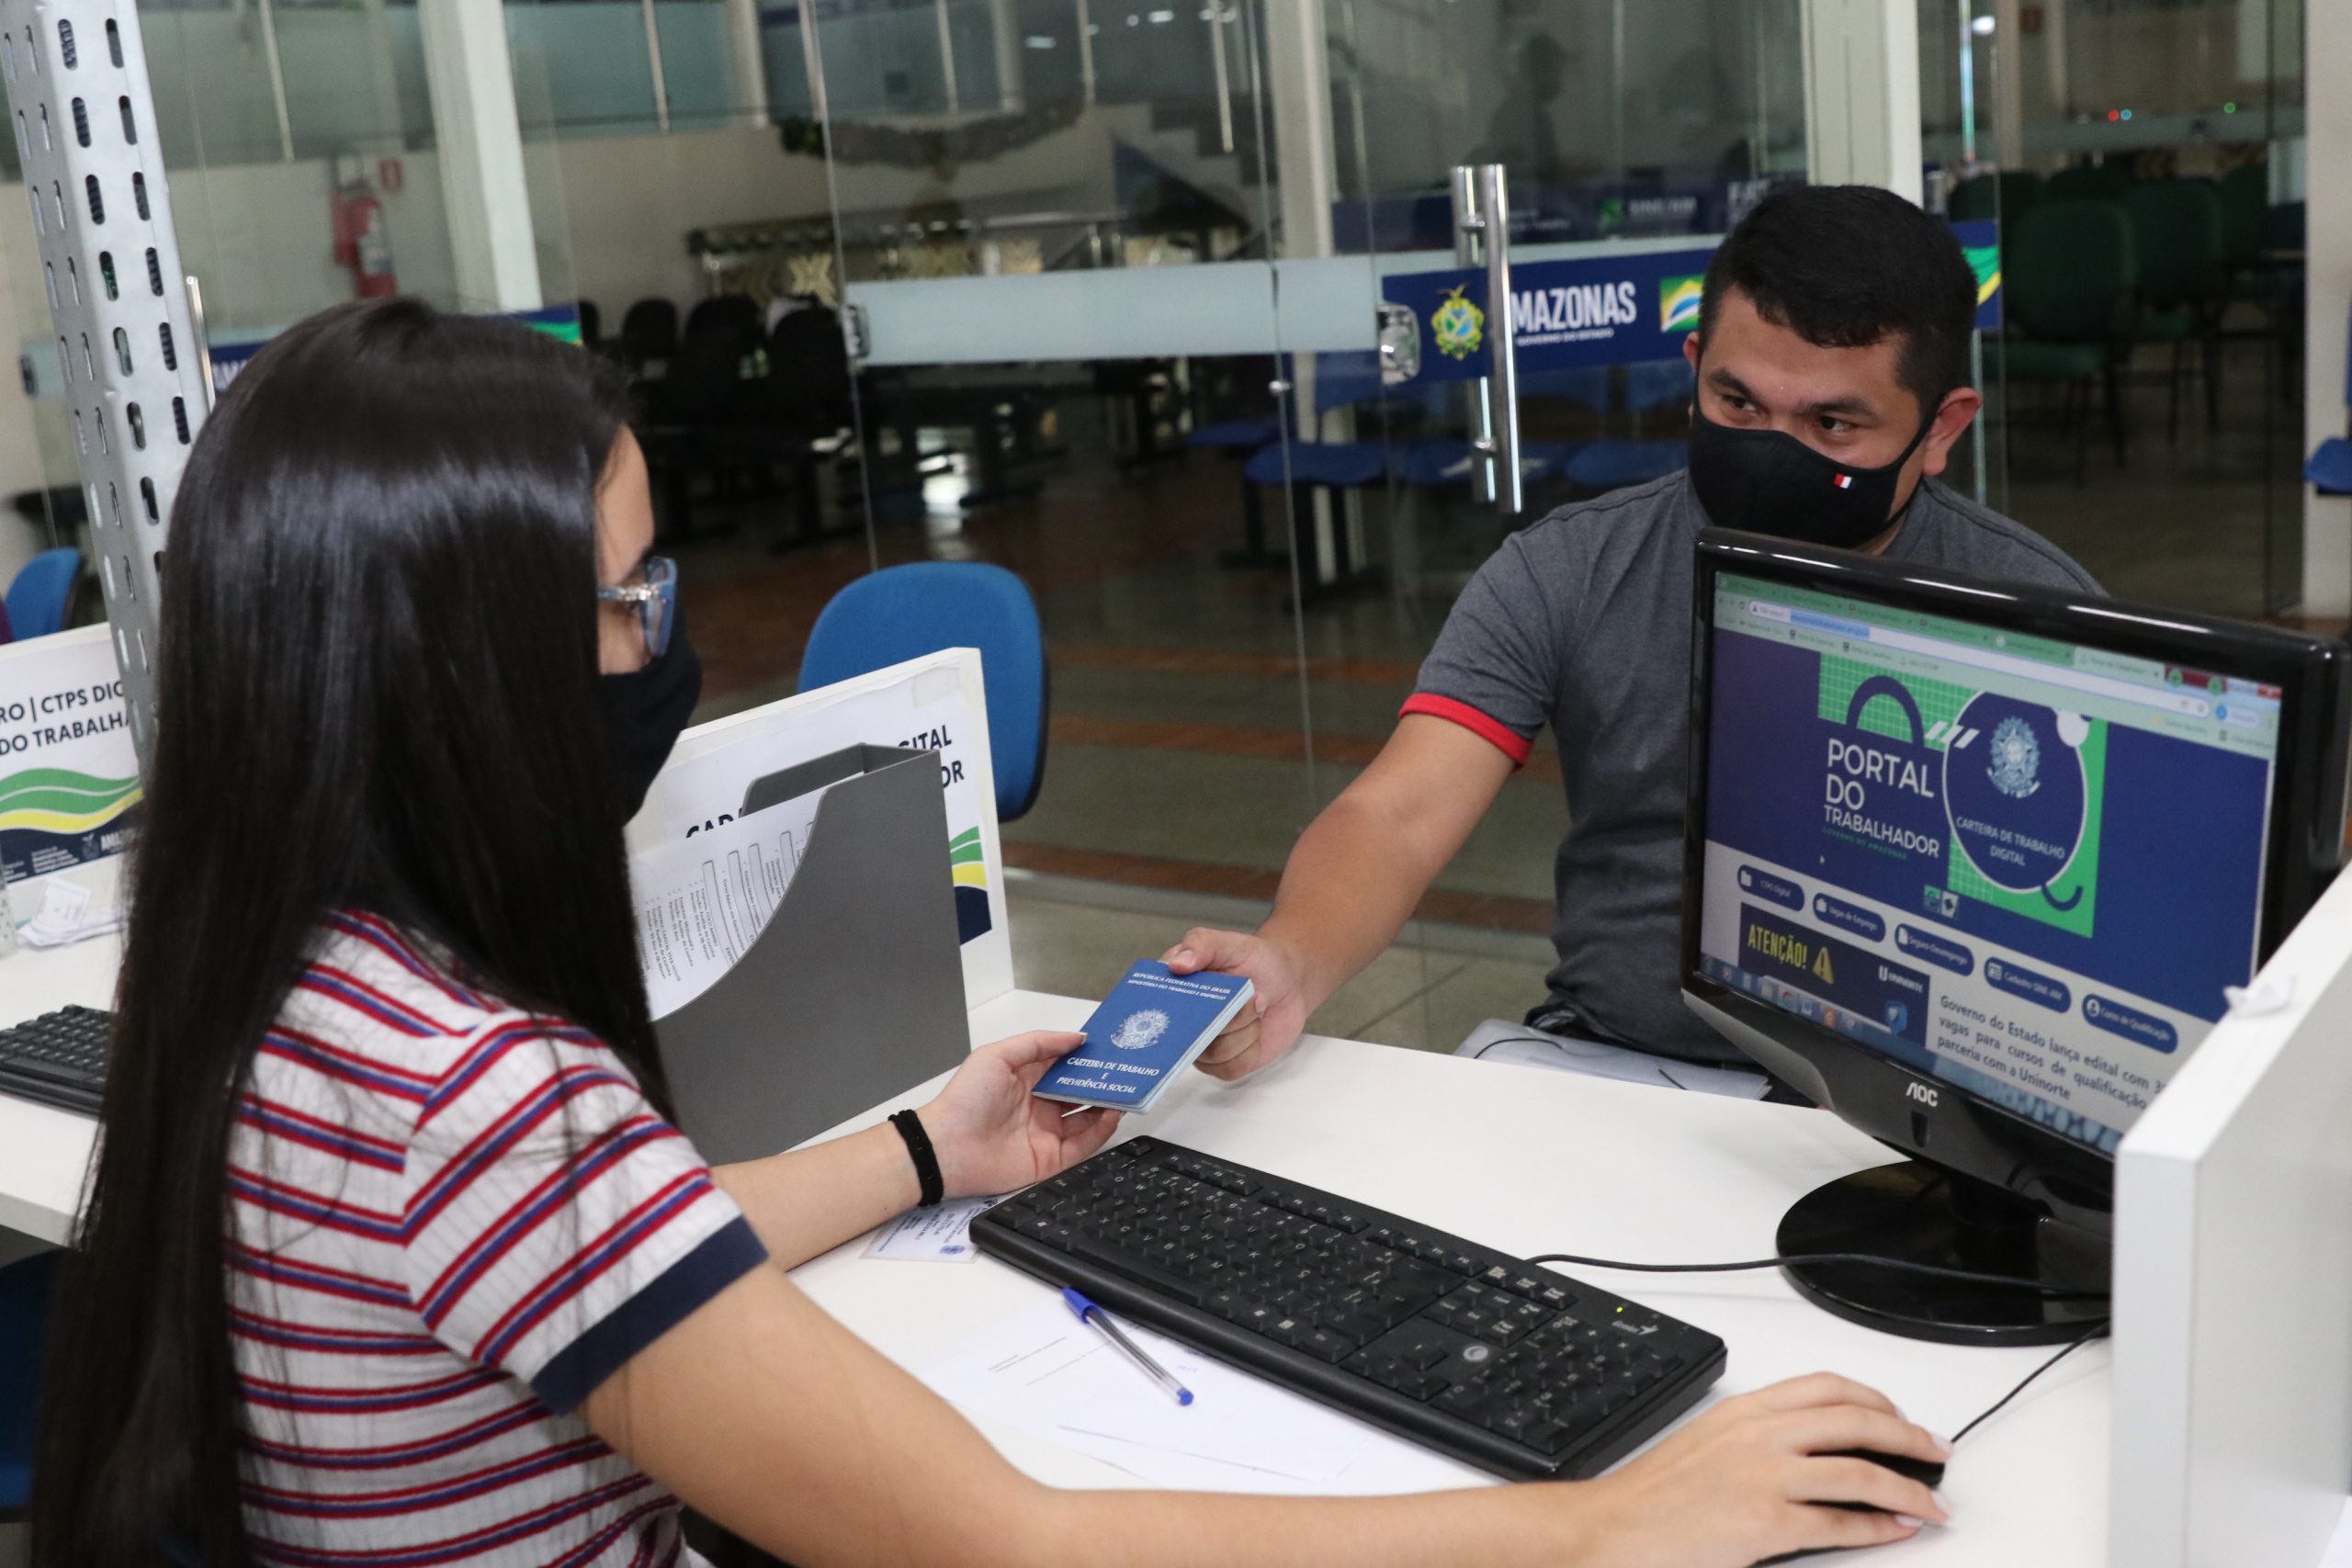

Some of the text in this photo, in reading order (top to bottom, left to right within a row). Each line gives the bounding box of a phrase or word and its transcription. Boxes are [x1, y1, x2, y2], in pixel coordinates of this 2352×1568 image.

[1517, 328, 1615, 346] GOVERNO DO ESTADO
[40, 688, 89, 714] CTPS
[32, 711, 130, 748] TRABALH
[1827, 738, 1935, 799] PORTAL
[1825, 773, 1864, 810] DO
[1824, 803, 1940, 858] TRABALHADOR
[1955, 815, 2064, 860] CARTEIRA DE TRABALHO
[1990, 844, 2025, 866] DIGITAL
[1827, 904, 1844, 920] Vagas
[1852, 914, 1876, 932] Emprego
[1746, 923, 1810, 971] ATENÇÃO!
[1126, 978, 1159, 987] MINISTÉRIO
[1167, 985, 1196, 995] TRABALHO
[1198, 991, 1227, 1000] EMPREGO
[1132, 971, 1165, 982] REPÚBLICA
[1163, 976, 1199, 988] FEDERATIVA
[1210, 986, 1231, 994] BRASIL
[1939, 994, 1986, 1024] Governo
[1987, 1016, 2006, 1032] do
[2007, 1021, 2047, 1048] Estado
[2048, 1038, 2081, 1065] lança
[2083, 1053, 2120, 1077] edital
[2121, 1071, 2149, 1090] com
[1066, 1056, 1160, 1077] CARTEIRA DE TRABALHO
[1101, 1071, 1109, 1079] E
[1936, 1034, 2071, 1100] parceria com a Uninorte
[1939, 1016, 2149, 1111] vagas para cursos de qualificação
[1056, 1076, 1136, 1094] PREVIDÊNCIA SOCIAL
[1905, 1080, 1938, 1107] AOC
